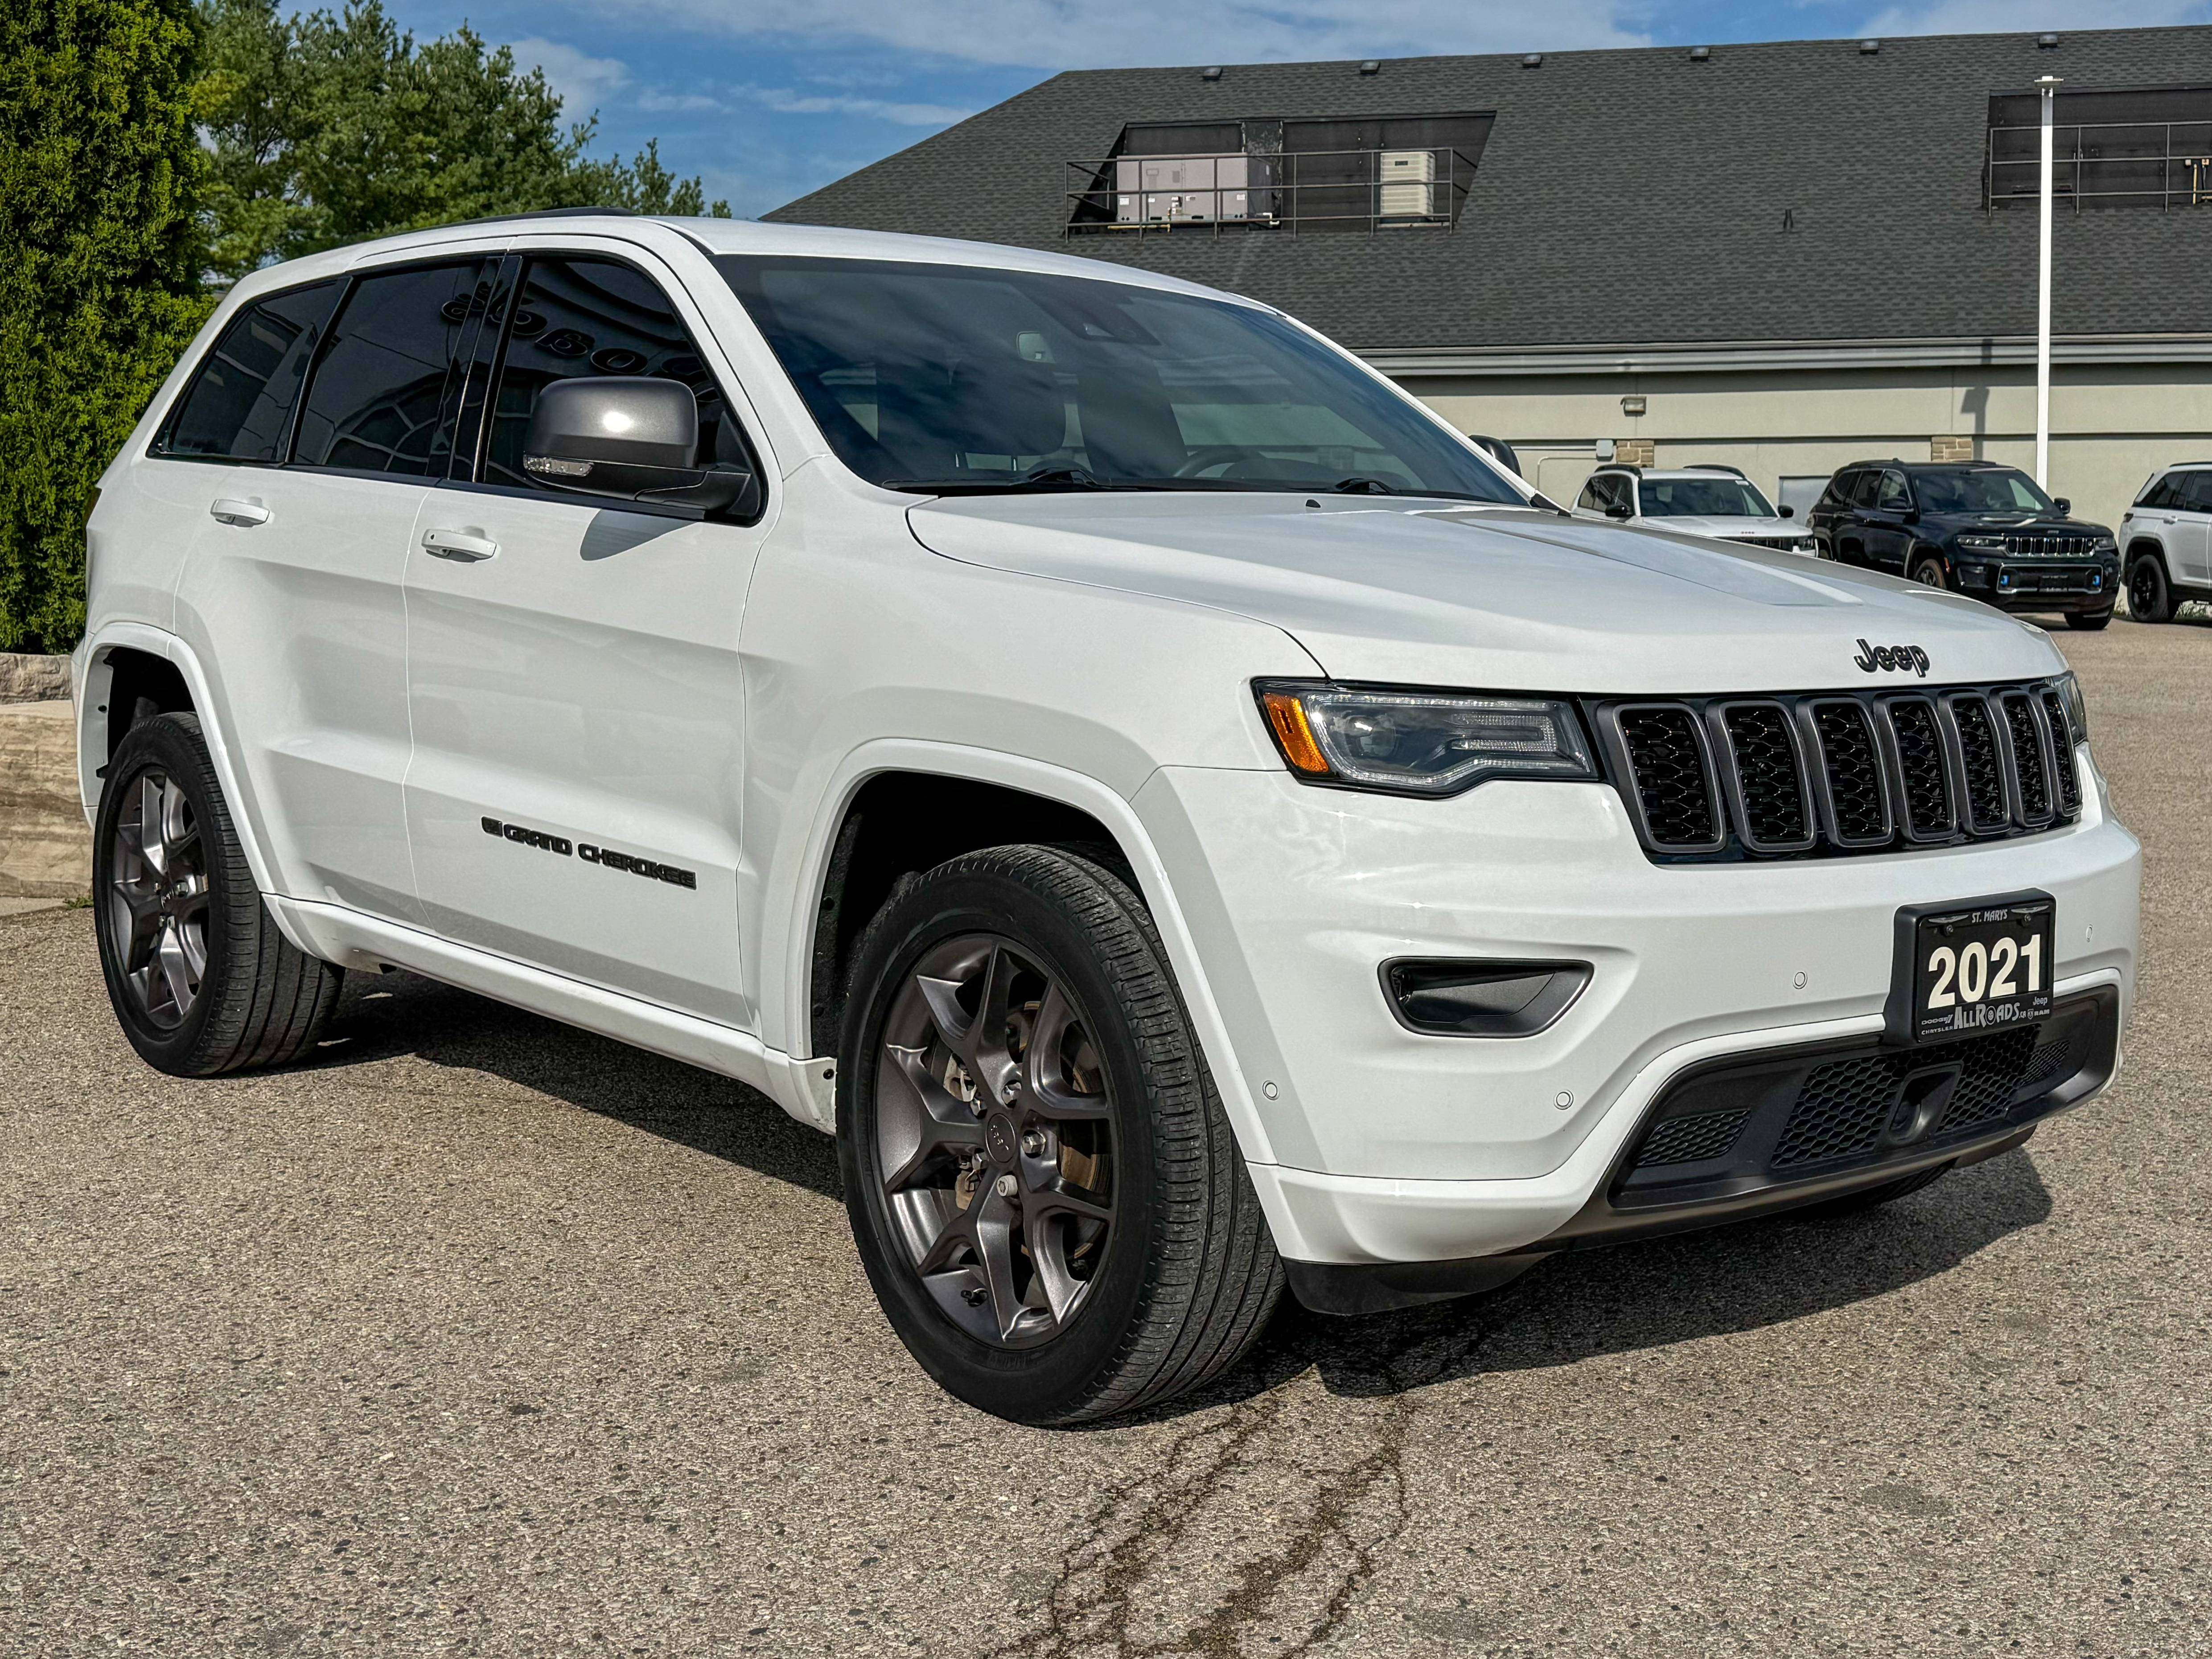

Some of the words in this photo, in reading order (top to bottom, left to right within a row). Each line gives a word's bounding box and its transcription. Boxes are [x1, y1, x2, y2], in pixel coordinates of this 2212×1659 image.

[1853, 639, 1930, 678] Jeep
[503, 823, 573, 857] GRAND
[578, 843, 697, 890] CHEROKEE
[1972, 912, 1982, 923] ST.
[1984, 909, 2008, 922] MARYS
[1928, 934, 2041, 1009] 2021
[2032, 996, 2048, 1006] Jeep
[1921, 1015, 1949, 1025] DODGE
[1921, 1025, 1954, 1035] CHRYSLER
